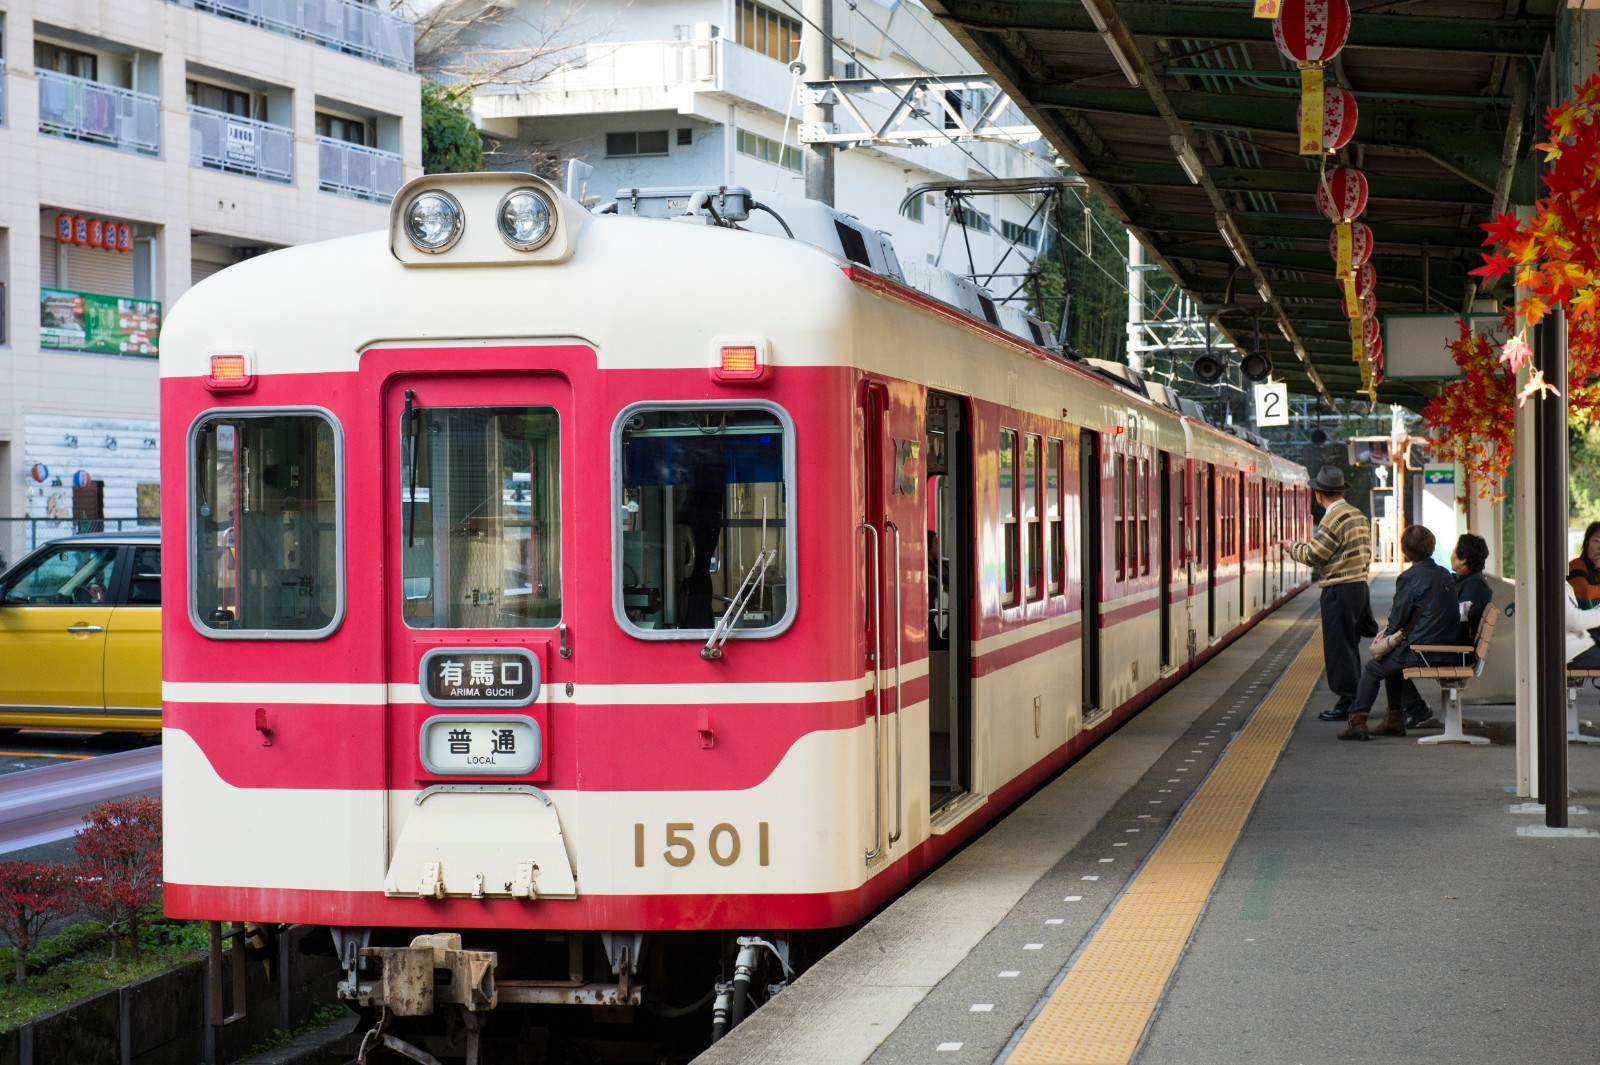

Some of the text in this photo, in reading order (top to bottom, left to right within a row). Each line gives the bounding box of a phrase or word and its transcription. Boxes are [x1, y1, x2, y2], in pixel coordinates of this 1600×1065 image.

[1264, 391, 1280, 418] 2
[439, 660, 523, 687] 有馬口
[450, 688, 514, 697] ARIMA GUCHI
[447, 728, 516, 755] 普通
[467, 756, 496, 765] LOCAL
[634, 821, 770, 868] 1501
